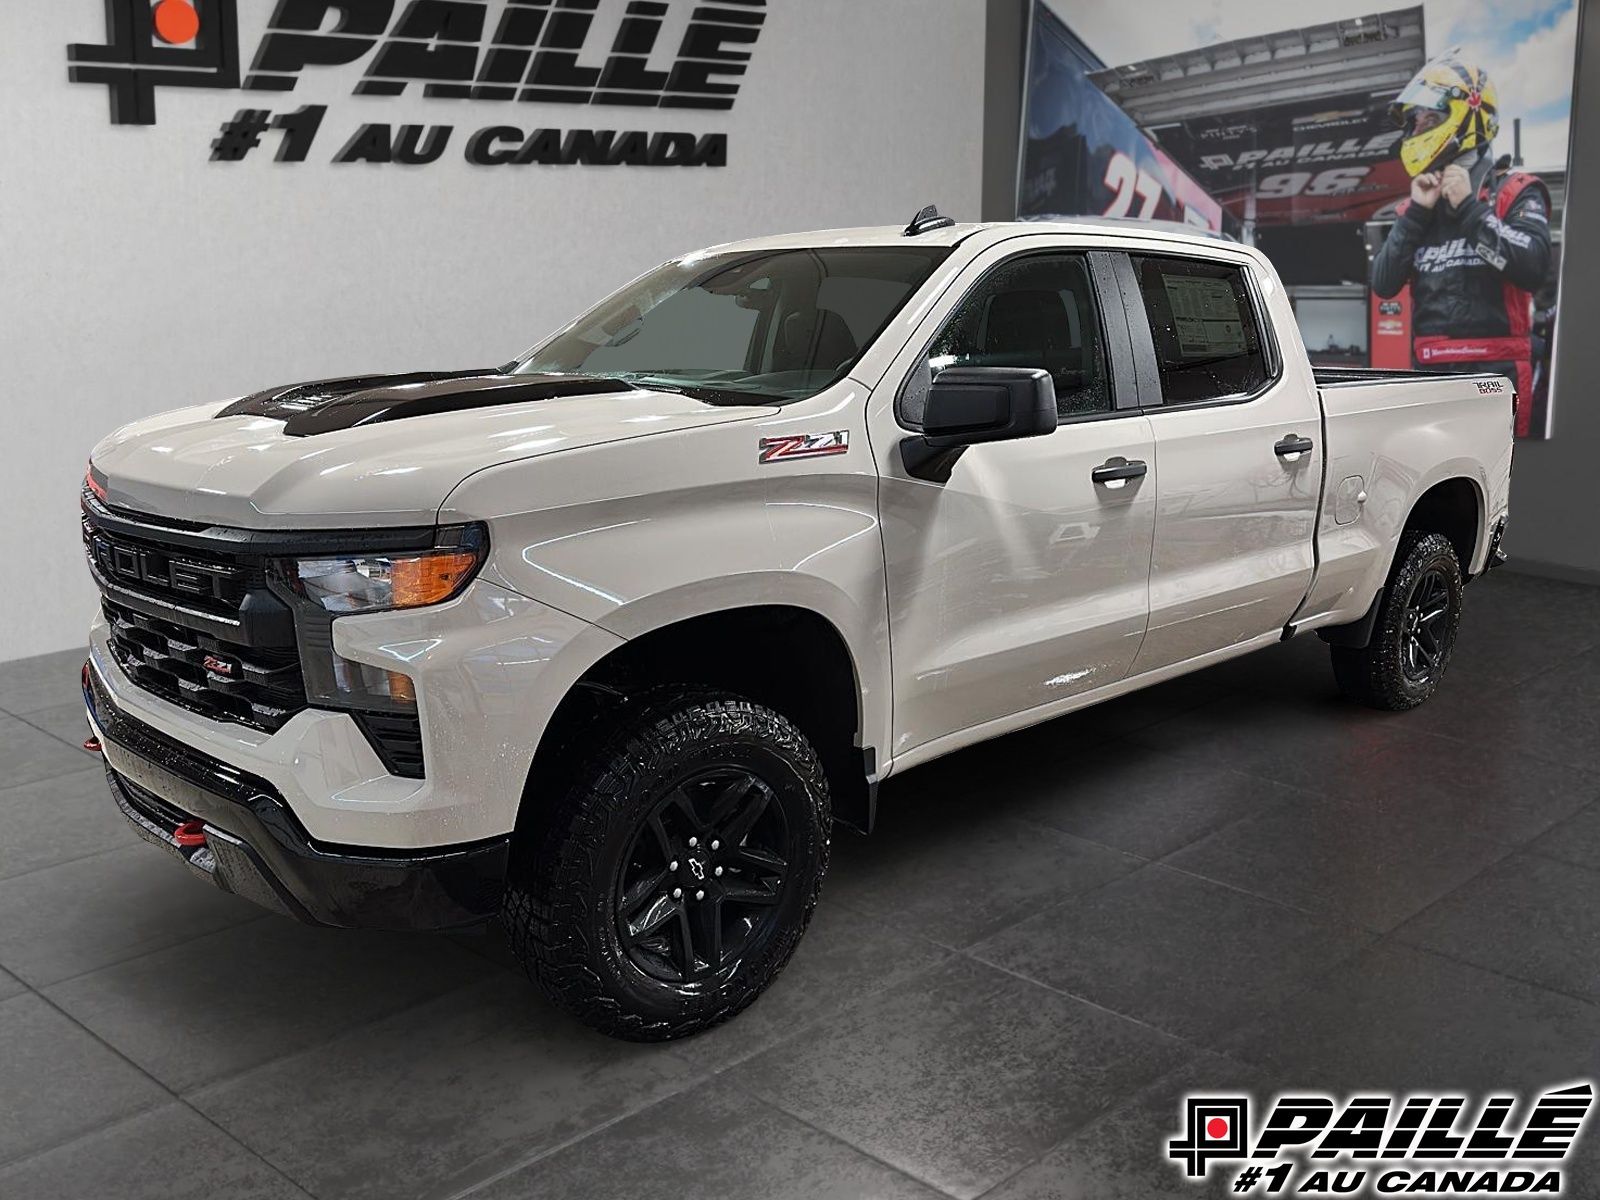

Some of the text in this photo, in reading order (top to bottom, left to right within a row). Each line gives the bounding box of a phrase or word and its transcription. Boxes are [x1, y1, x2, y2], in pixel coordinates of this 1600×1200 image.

[210, 105, 728, 167] #1 AU CANADA
[1297, 149, 1390, 164] CANADA
[1104, 151, 1162, 220] 27
[1255, 167, 1373, 199] 96
[1472, 380, 1504, 389] TRAIL
[759, 430, 849, 464] Z71
